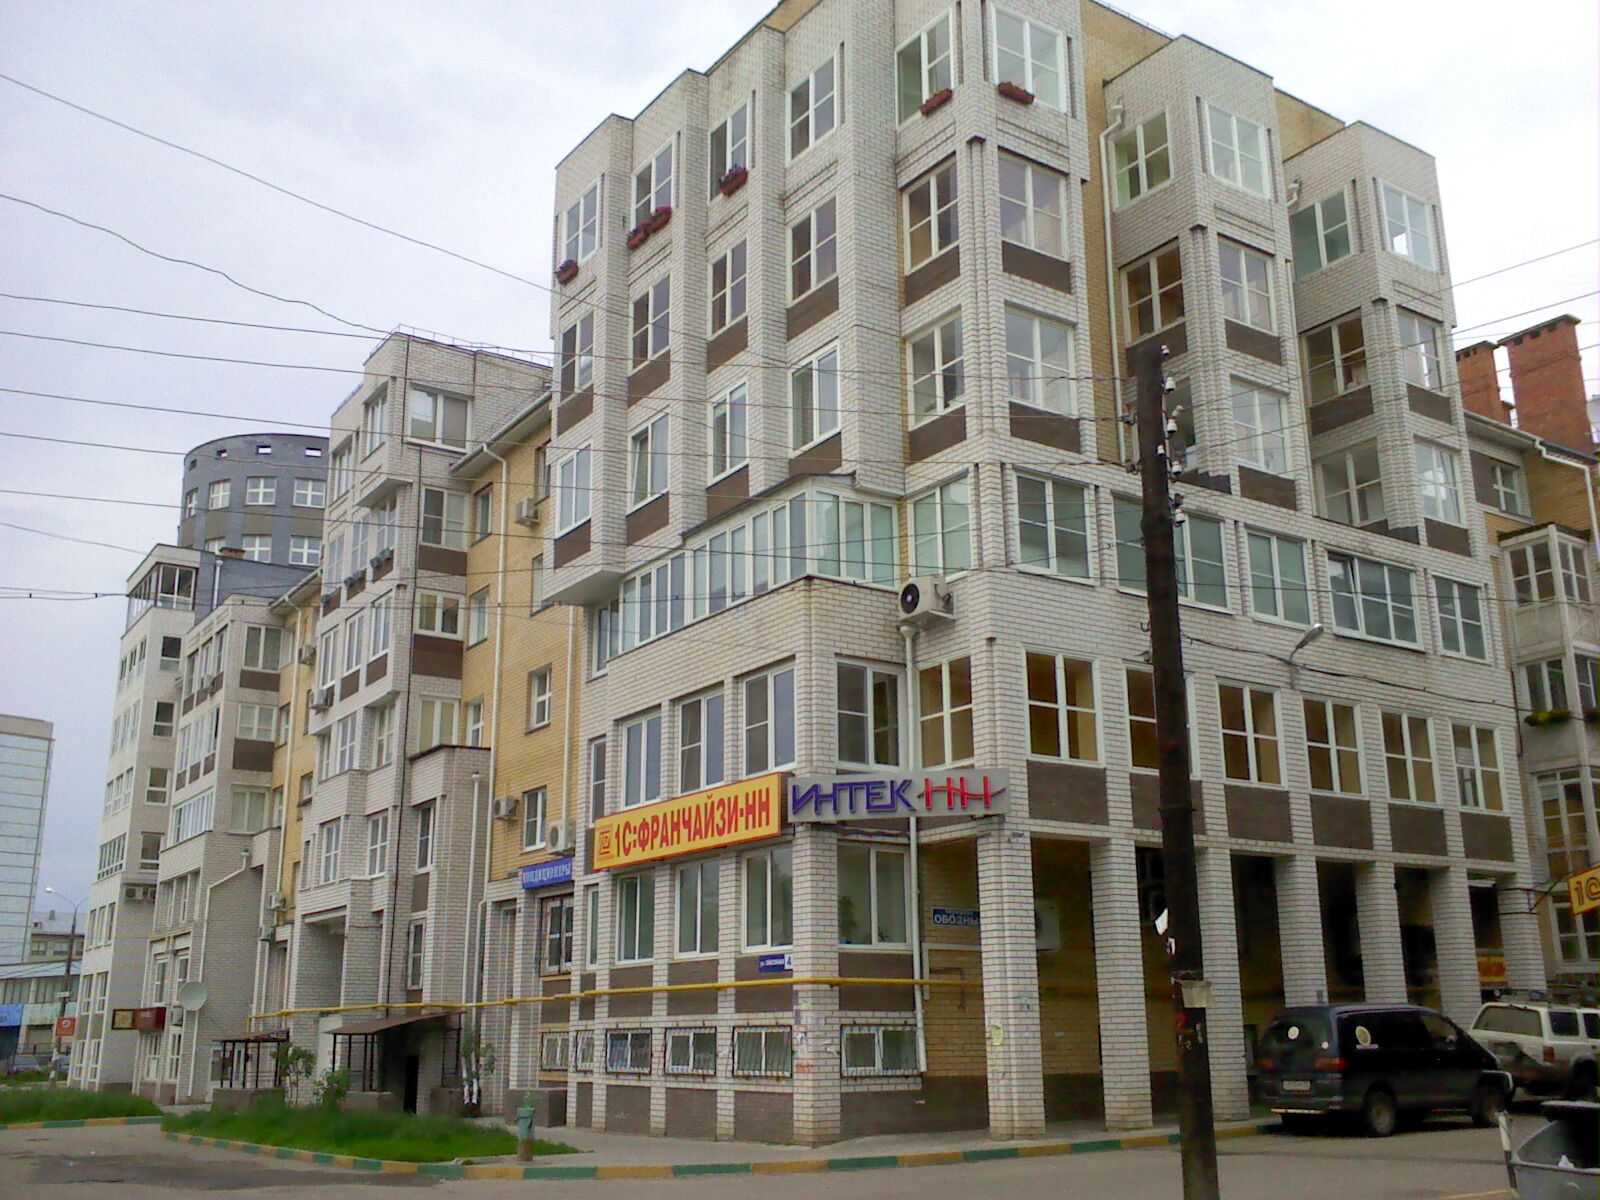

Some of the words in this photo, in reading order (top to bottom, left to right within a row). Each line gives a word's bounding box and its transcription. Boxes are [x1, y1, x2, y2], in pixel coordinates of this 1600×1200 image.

[614, 786, 771, 858] 1С:ФРАНЧАЙЗИ-НН
[791, 779, 916, 816] ИНТЕК
[917, 775, 1006, 810] НН
